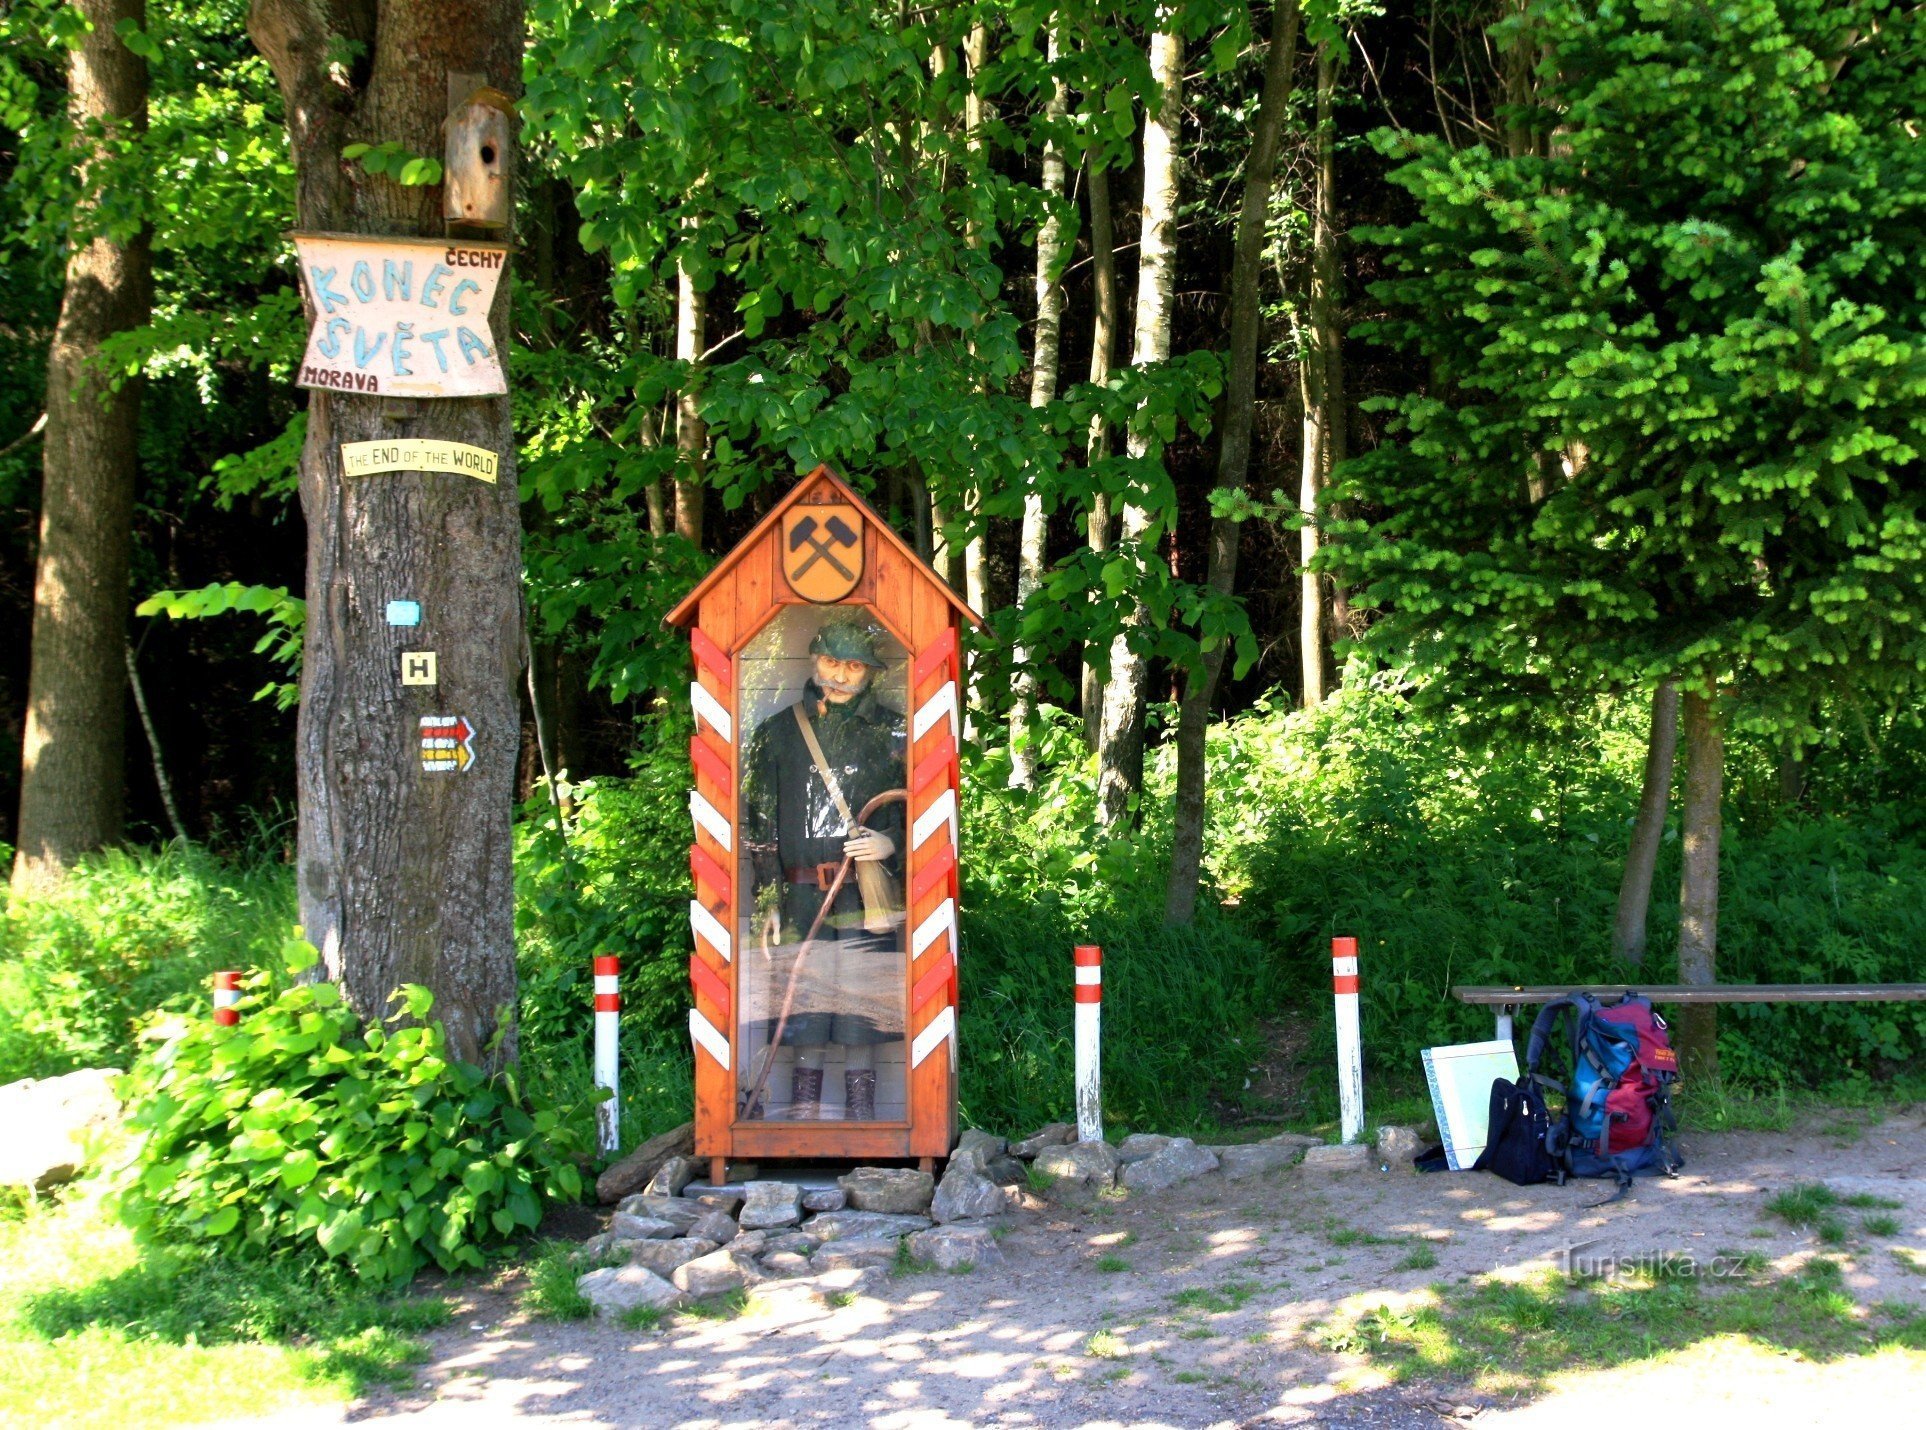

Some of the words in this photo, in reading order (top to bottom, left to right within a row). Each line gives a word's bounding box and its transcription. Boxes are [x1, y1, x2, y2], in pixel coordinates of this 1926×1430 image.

[446, 247, 503, 269] ČECHY
[310, 259, 482, 316] KONEC
[316, 317, 490, 376] SVĚTA
[302, 366, 379, 393] MORAVA
[349, 454, 369, 468] THE
[372, 447, 400, 464] END
[403, 451, 420, 463] OF
[425, 451, 449, 465] THE
[452, 449, 494, 475] WORLD
[409, 658, 429, 678] H
